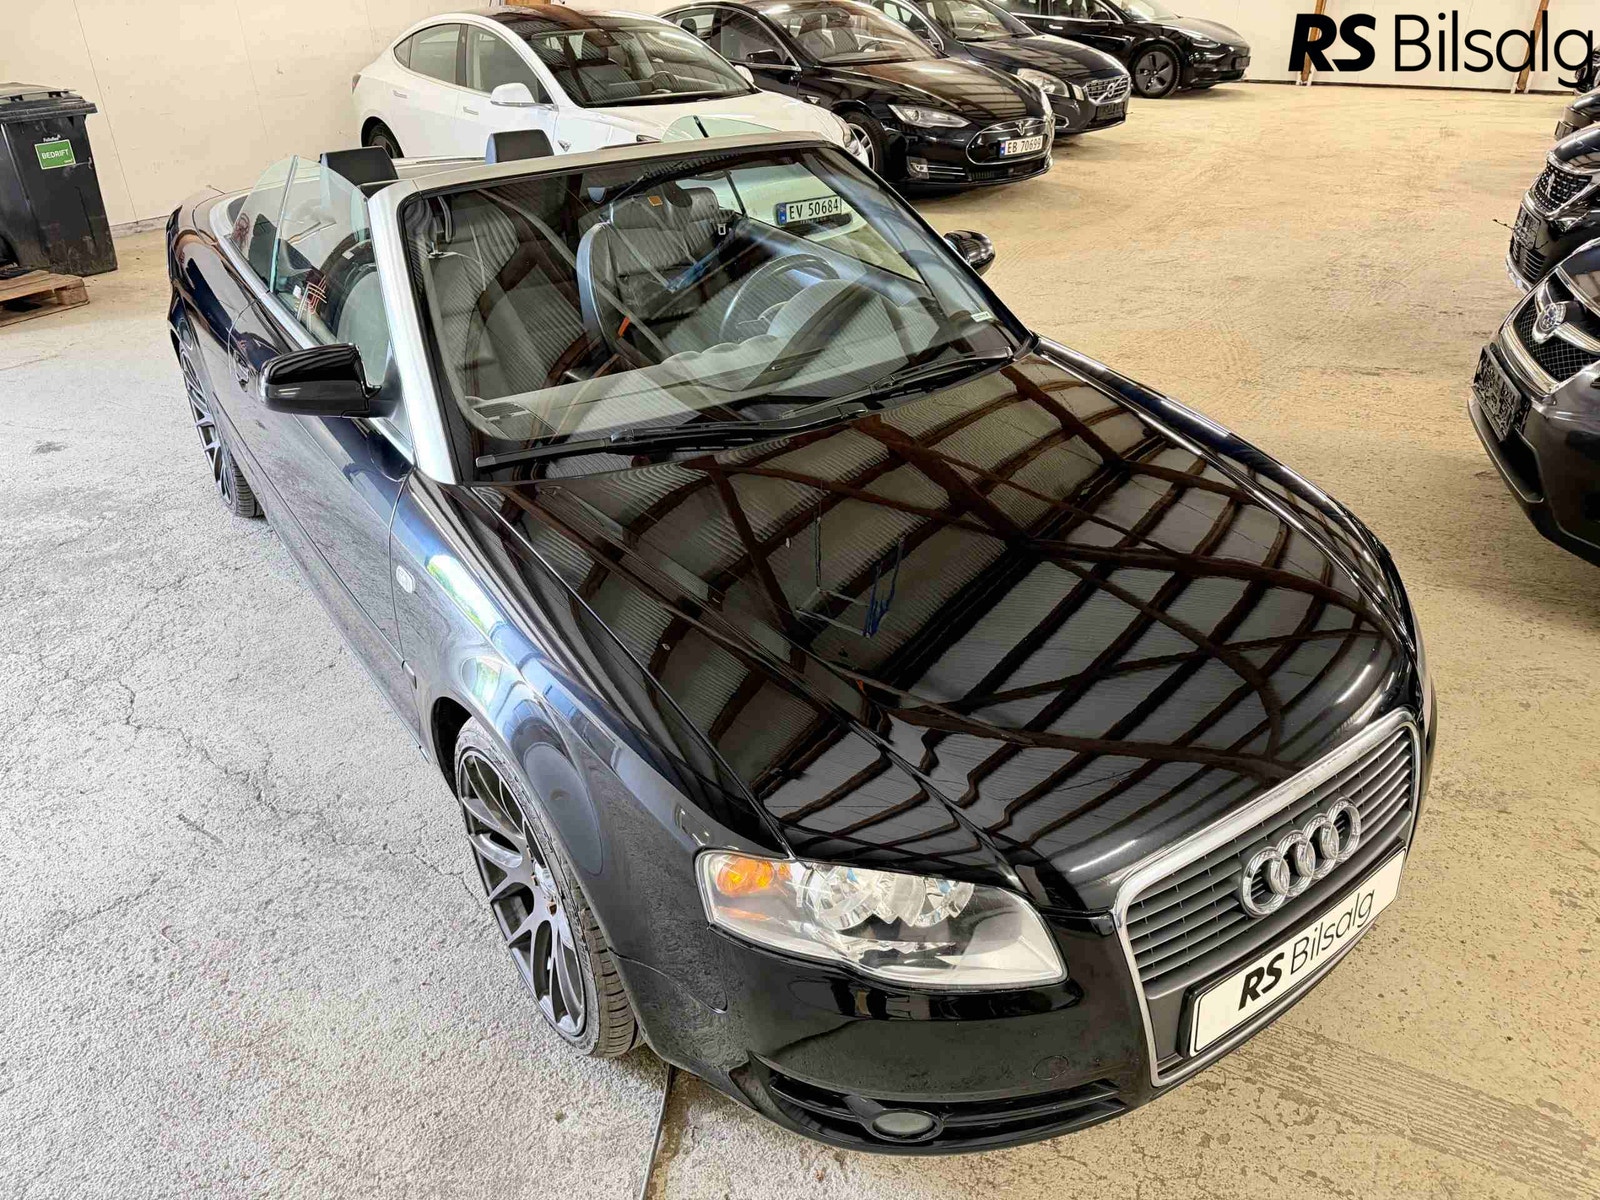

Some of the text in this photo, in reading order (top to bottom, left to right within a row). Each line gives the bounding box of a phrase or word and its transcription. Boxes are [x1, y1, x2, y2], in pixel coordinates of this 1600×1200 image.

[41, 149, 69, 160] BEDRIFT
[1007, 141, 1018, 154] EB
[789, 198, 839, 220] EV 50684
[1238, 889, 1375, 1011] RS Bilsalg
